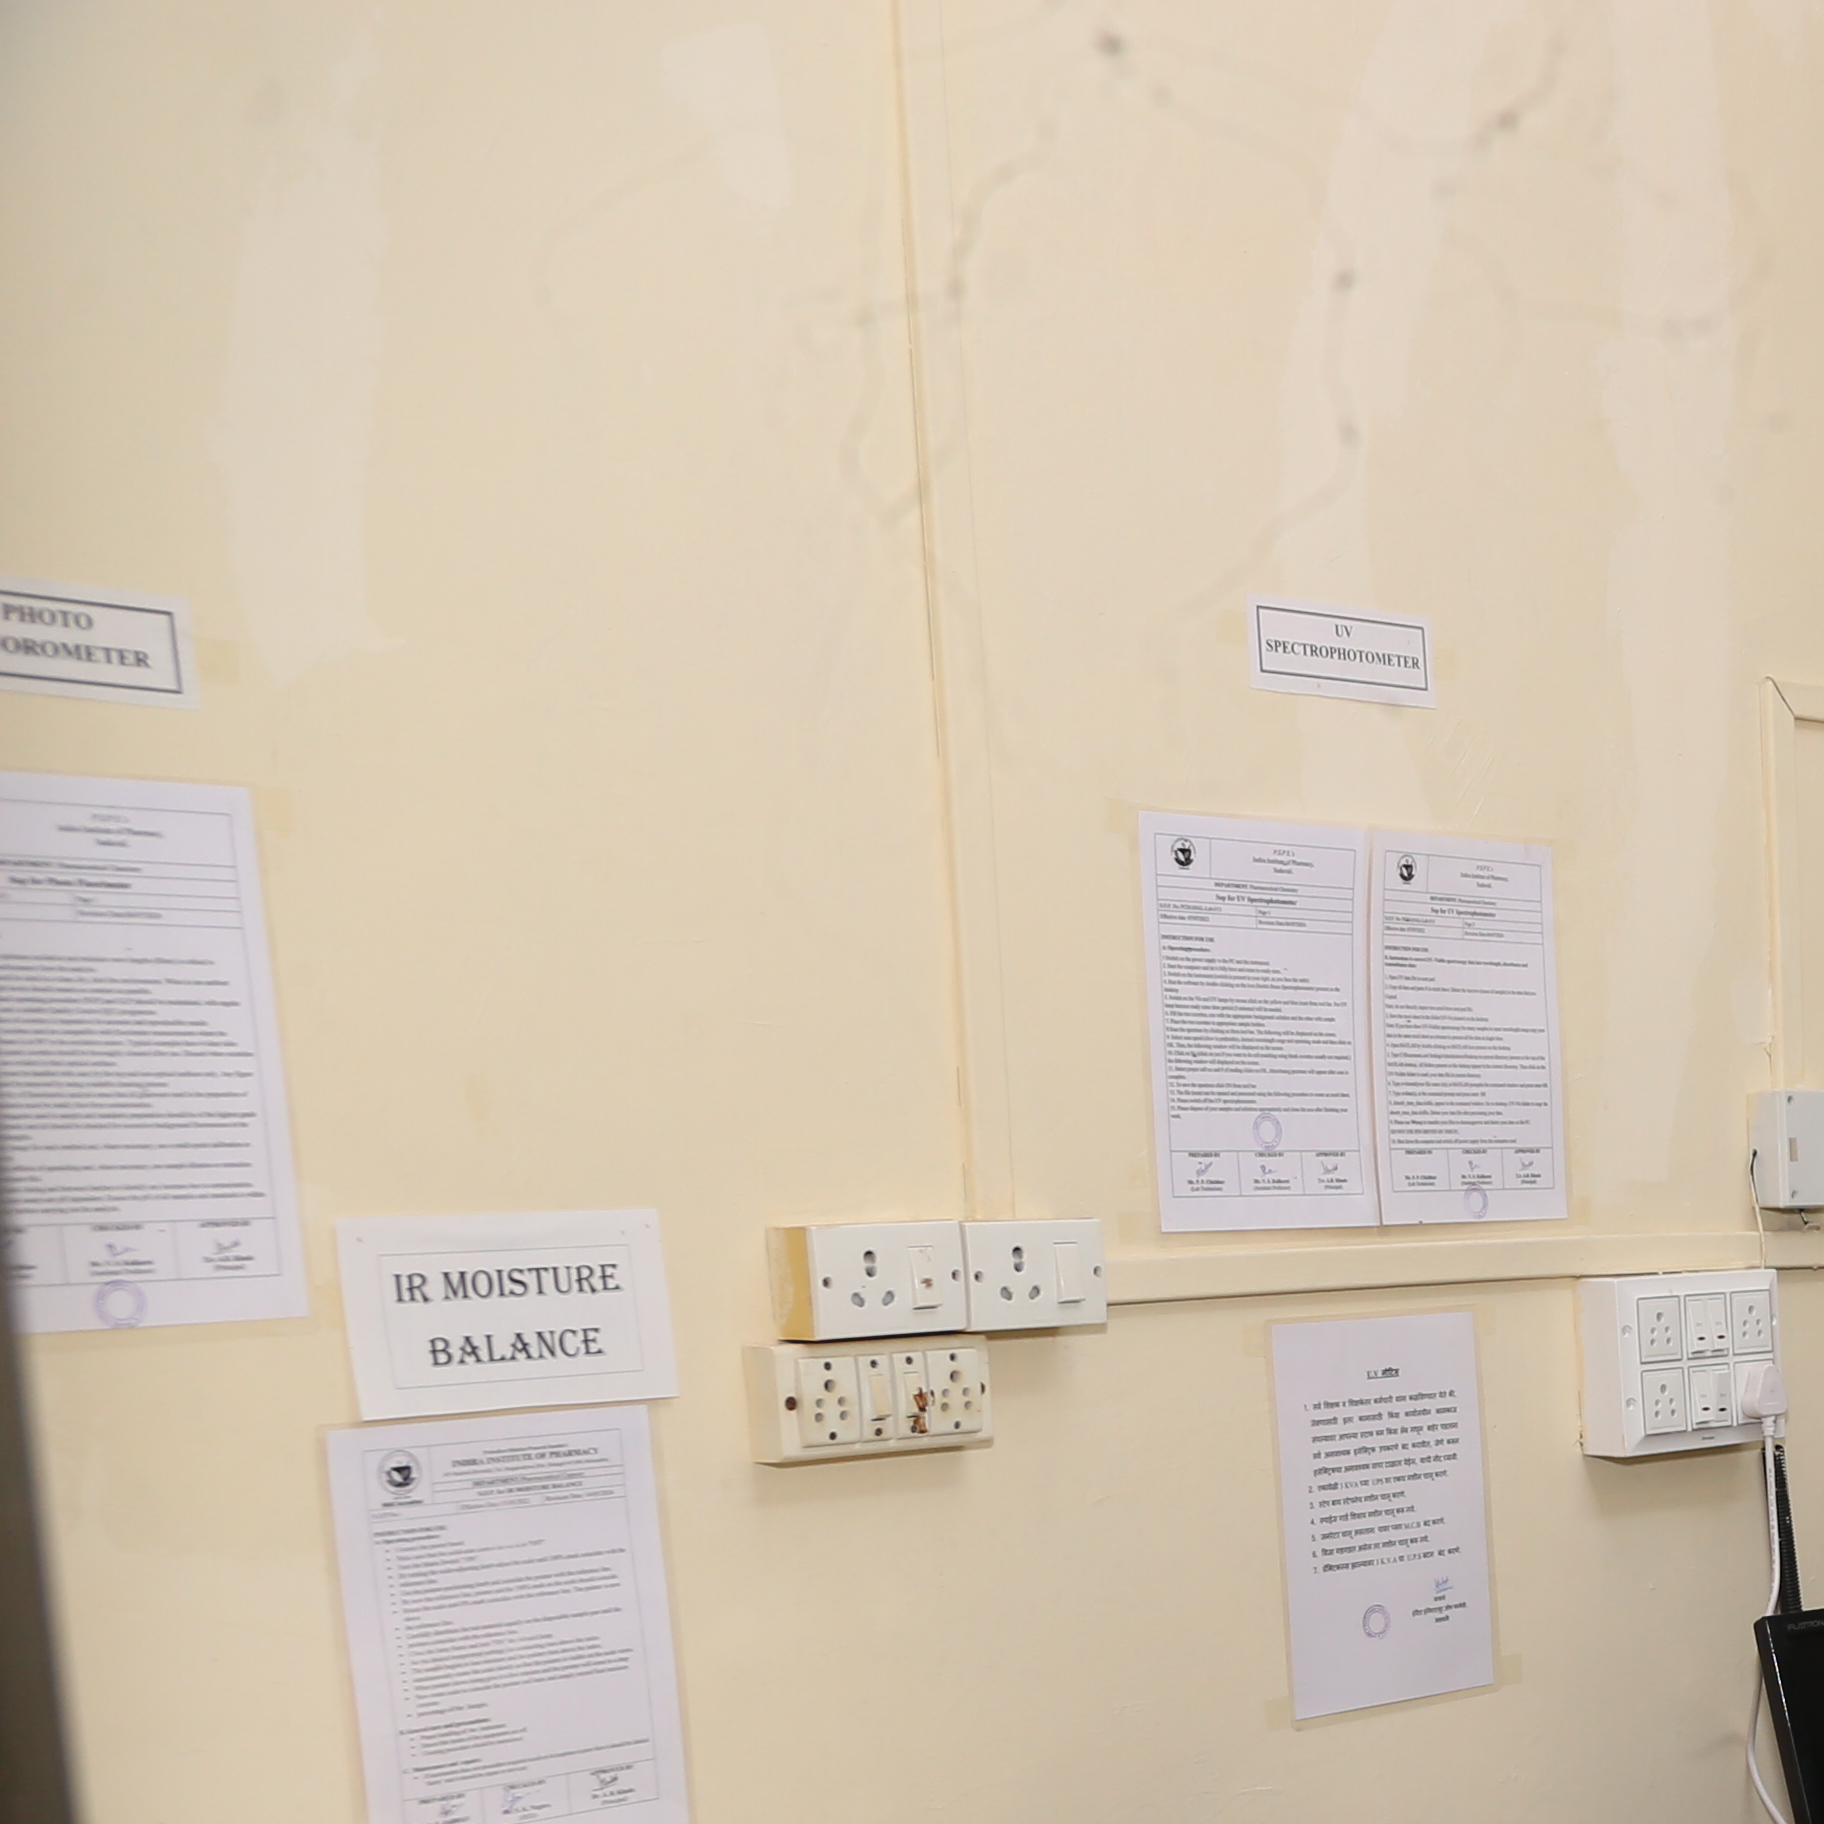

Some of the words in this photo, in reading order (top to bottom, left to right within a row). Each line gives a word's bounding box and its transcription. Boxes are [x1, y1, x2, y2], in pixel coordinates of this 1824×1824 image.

[1, 602, 95, 631] PHOTO
[1334, 623, 1353, 638] UV
[1265, 638, 1422, 670] SPECTROPHOTOMETER
[392, 1272, 433, 1305] IR
[441, 1263, 624, 1301] MOISTURE
[428, 1327, 606, 1368] BALANCE
